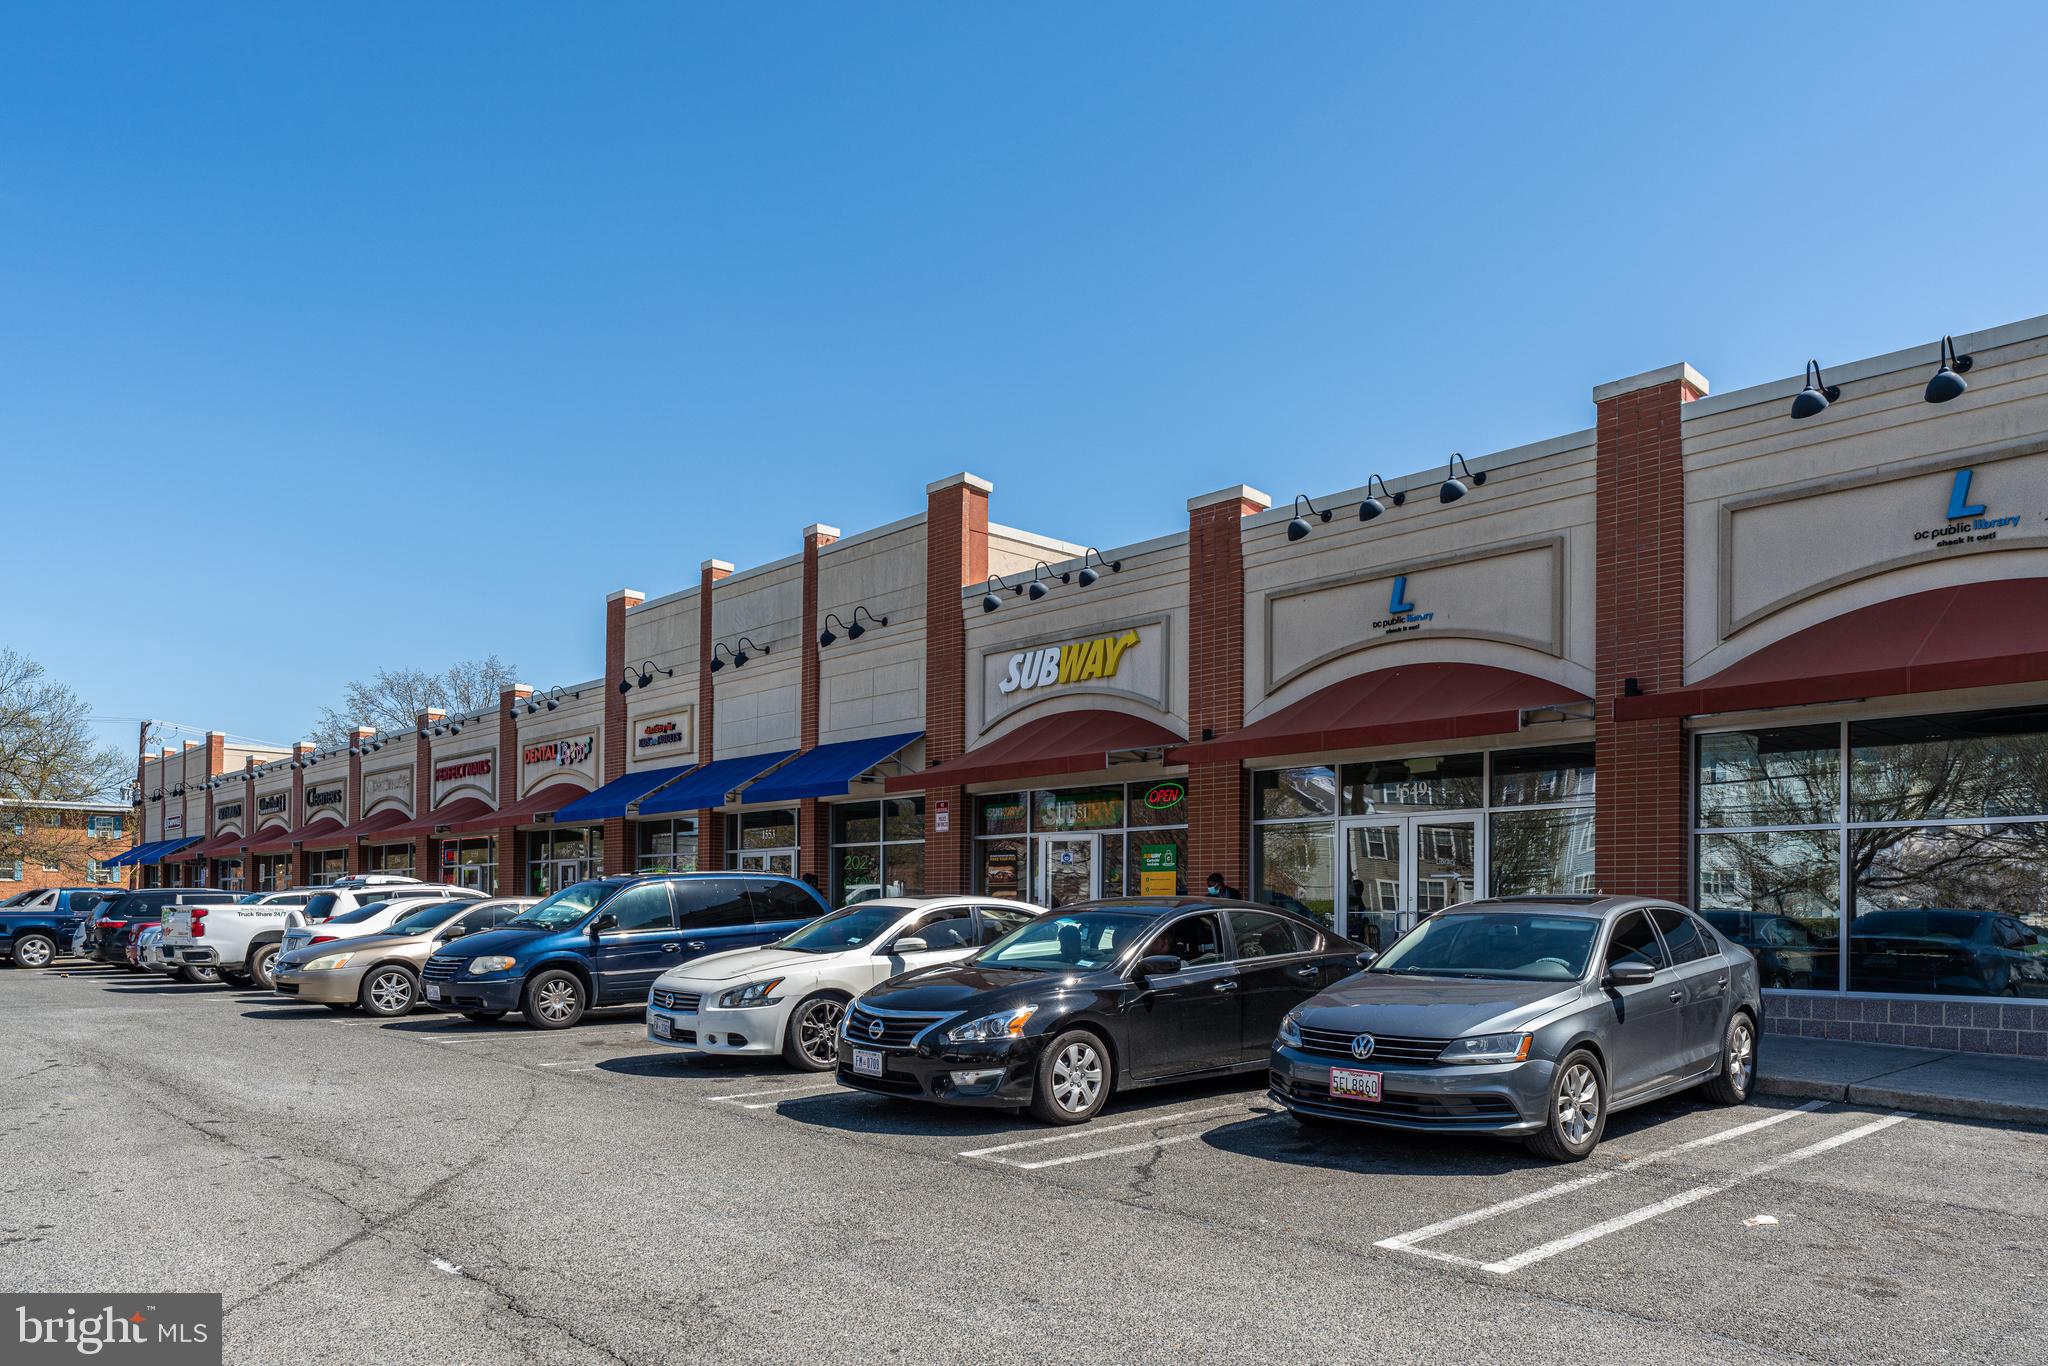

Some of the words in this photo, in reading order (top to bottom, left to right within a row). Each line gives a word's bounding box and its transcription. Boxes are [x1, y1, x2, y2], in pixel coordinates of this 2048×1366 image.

[1947, 468, 1987, 520] L
[1931, 522, 1971, 540] public
[1973, 515, 2021, 531] library
[1936, 537, 1964, 547] check
[1967, 535, 1974, 543] it
[1977, 531, 1997, 541] out!
[1389, 575, 1415, 615] L
[1383, 616, 1406, 629] public
[1407, 612, 1434, 622] library
[999, 629, 1140, 694] SUBWAY
[524, 744, 556, 764] DENTAL
[435, 763, 467, 782] PERFECT
[467, 759, 491, 776] NAILS
[307, 787, 342, 808] Cleaners
[1149, 789, 1179, 803] OPEN
[1395, 781, 1427, 799] 1549
[762, 828, 776, 840] 1553
